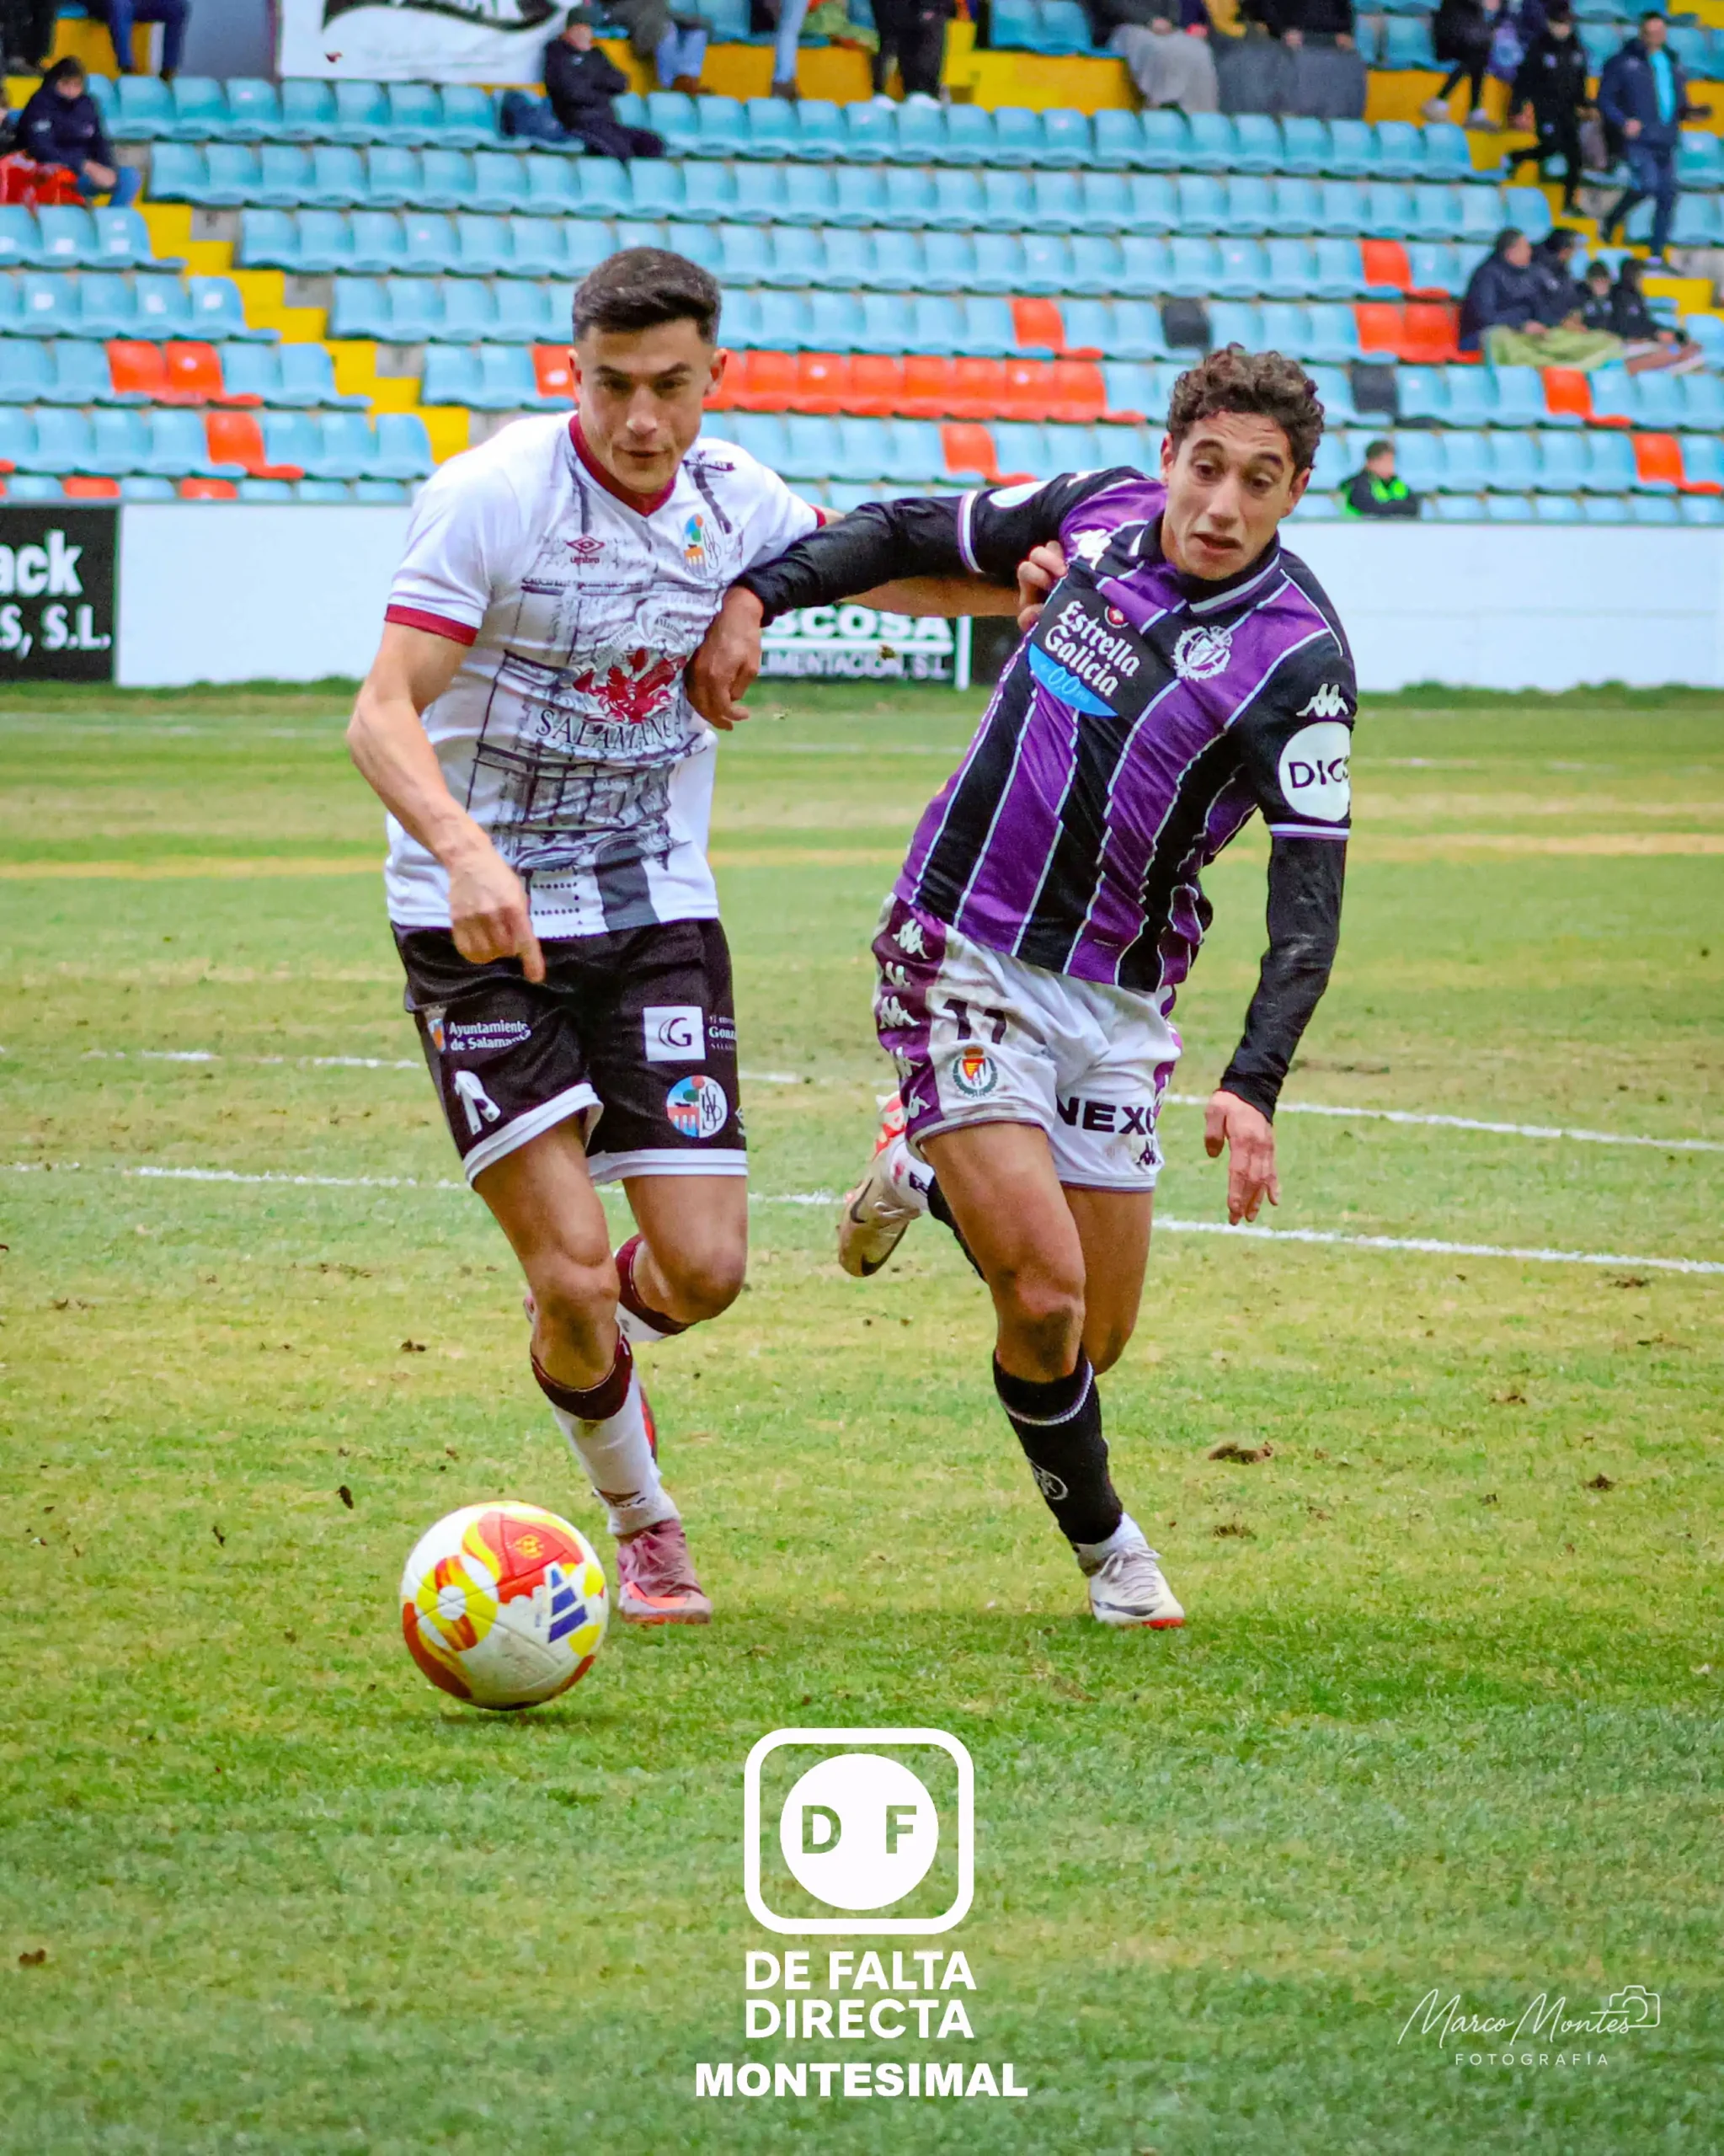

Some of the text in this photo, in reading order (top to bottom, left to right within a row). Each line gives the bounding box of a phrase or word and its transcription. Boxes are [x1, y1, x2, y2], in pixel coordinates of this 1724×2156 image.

[570, 556, 600, 565] umbro
[42, 603, 111, 651] S.L.
[1058, 600, 1140, 677] Estrella
[1044, 624, 1118, 696] Galicia
[450, 1039, 465, 1051] de
